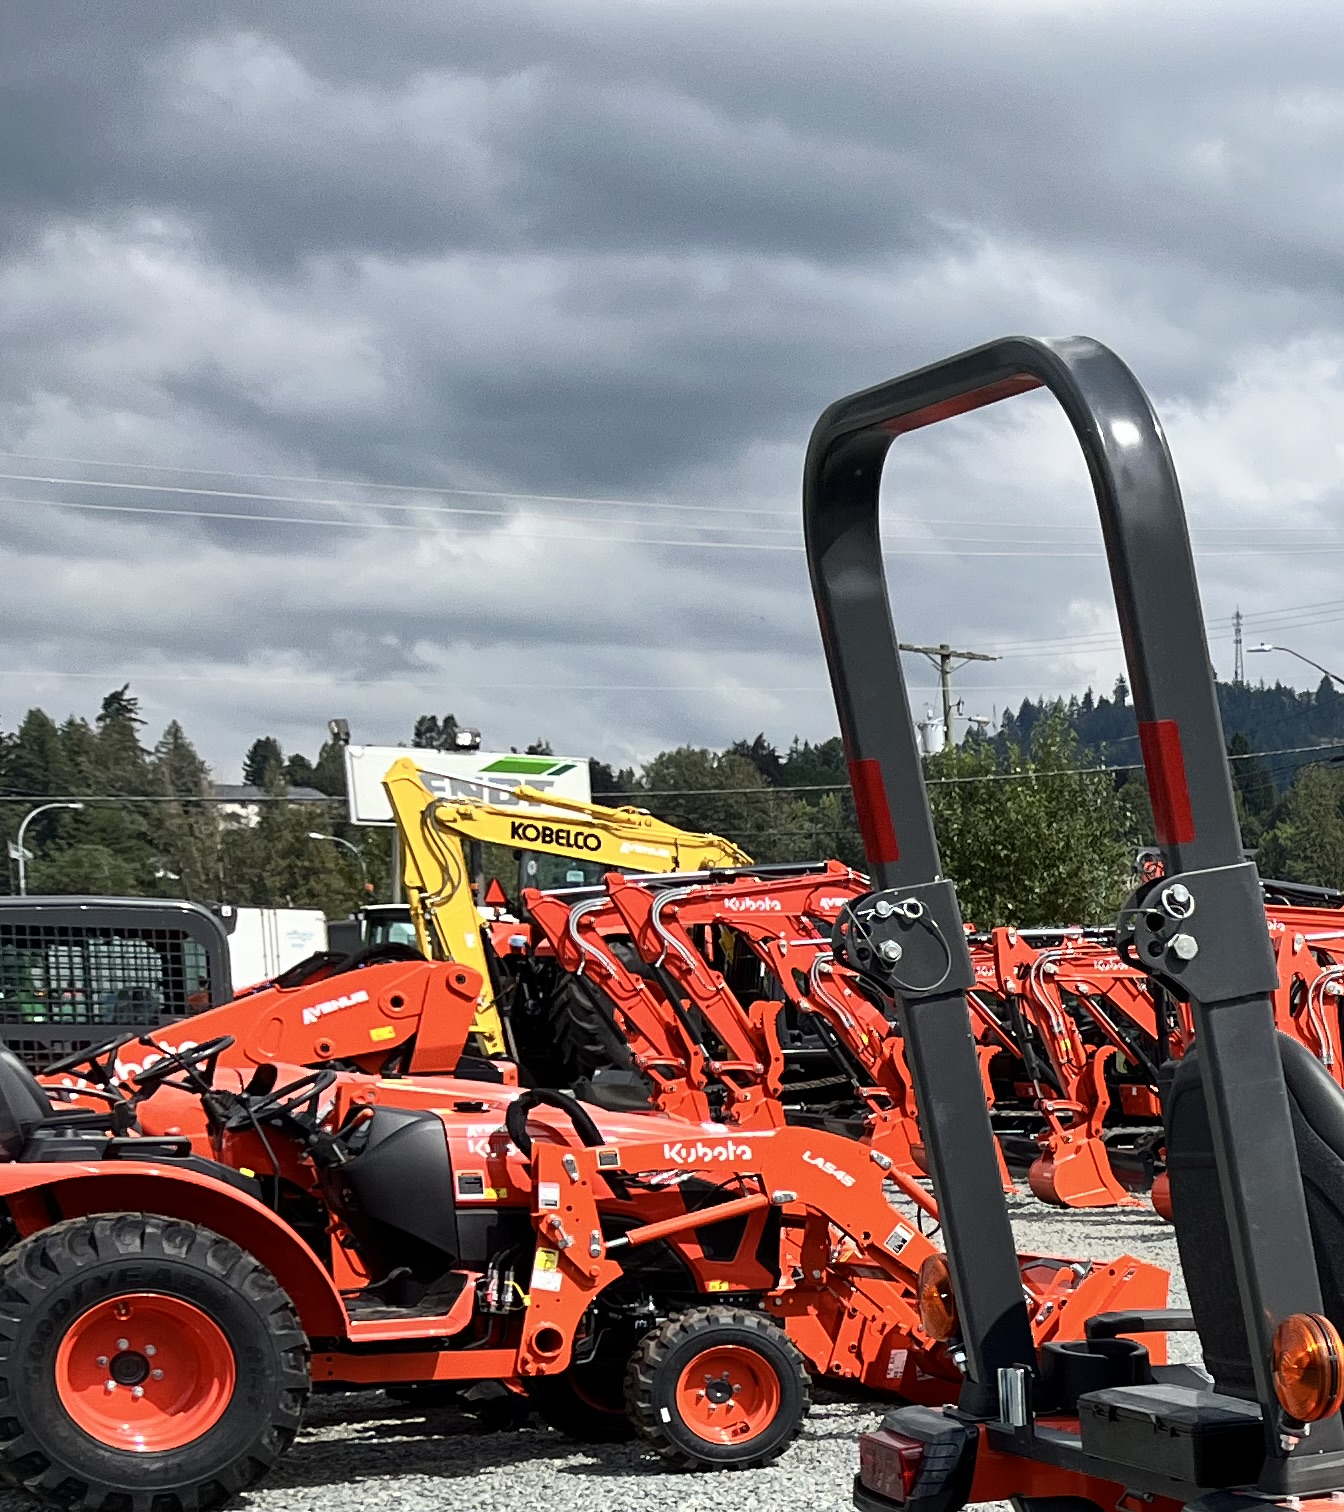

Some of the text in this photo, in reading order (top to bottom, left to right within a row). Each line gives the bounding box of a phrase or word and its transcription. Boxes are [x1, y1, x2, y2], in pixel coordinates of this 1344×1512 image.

[510, 821, 601, 852] KOBELCO
[724, 897, 782, 911] Kubota
[663, 1141, 752, 1164] Kubota
[801, 1150, 857, 1187] LA545
